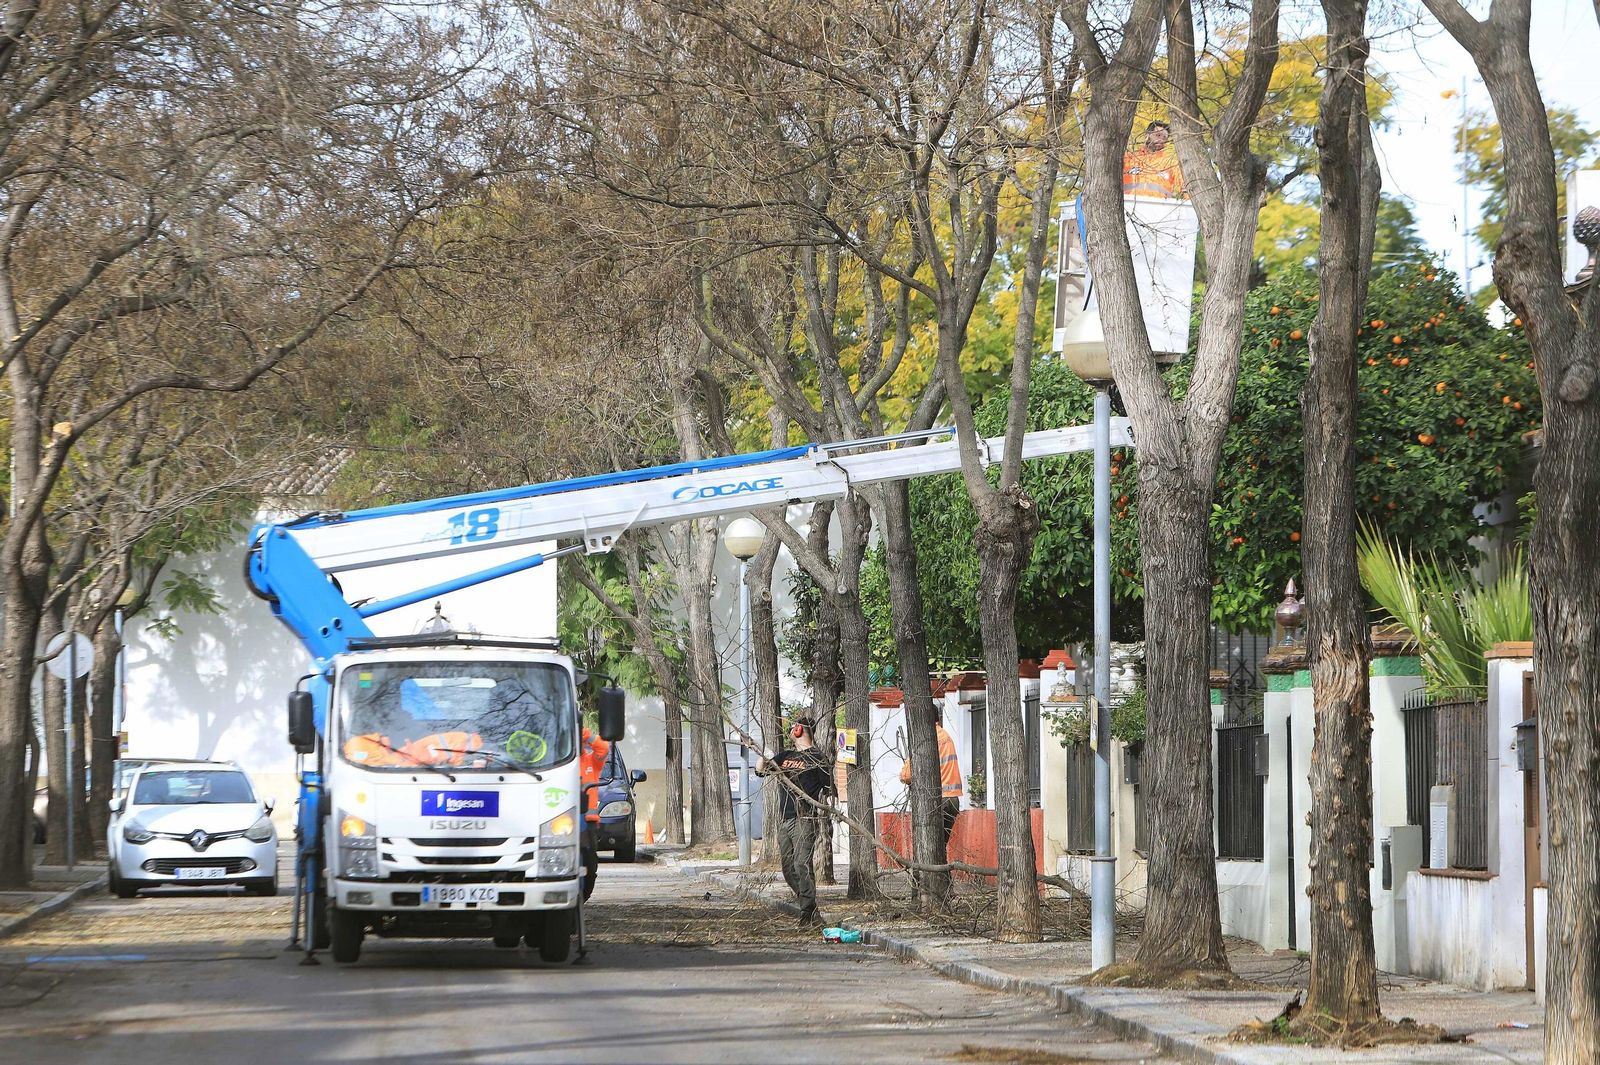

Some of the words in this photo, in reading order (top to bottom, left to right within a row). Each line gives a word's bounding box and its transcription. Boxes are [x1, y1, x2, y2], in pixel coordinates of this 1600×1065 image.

[781, 760, 806, 769] STIHL
[446, 797, 485, 812] Ingesan
[430, 820, 487, 830] ISUZU
[432, 888, 466, 901] 1980
[469, 888, 495, 901] KZC
